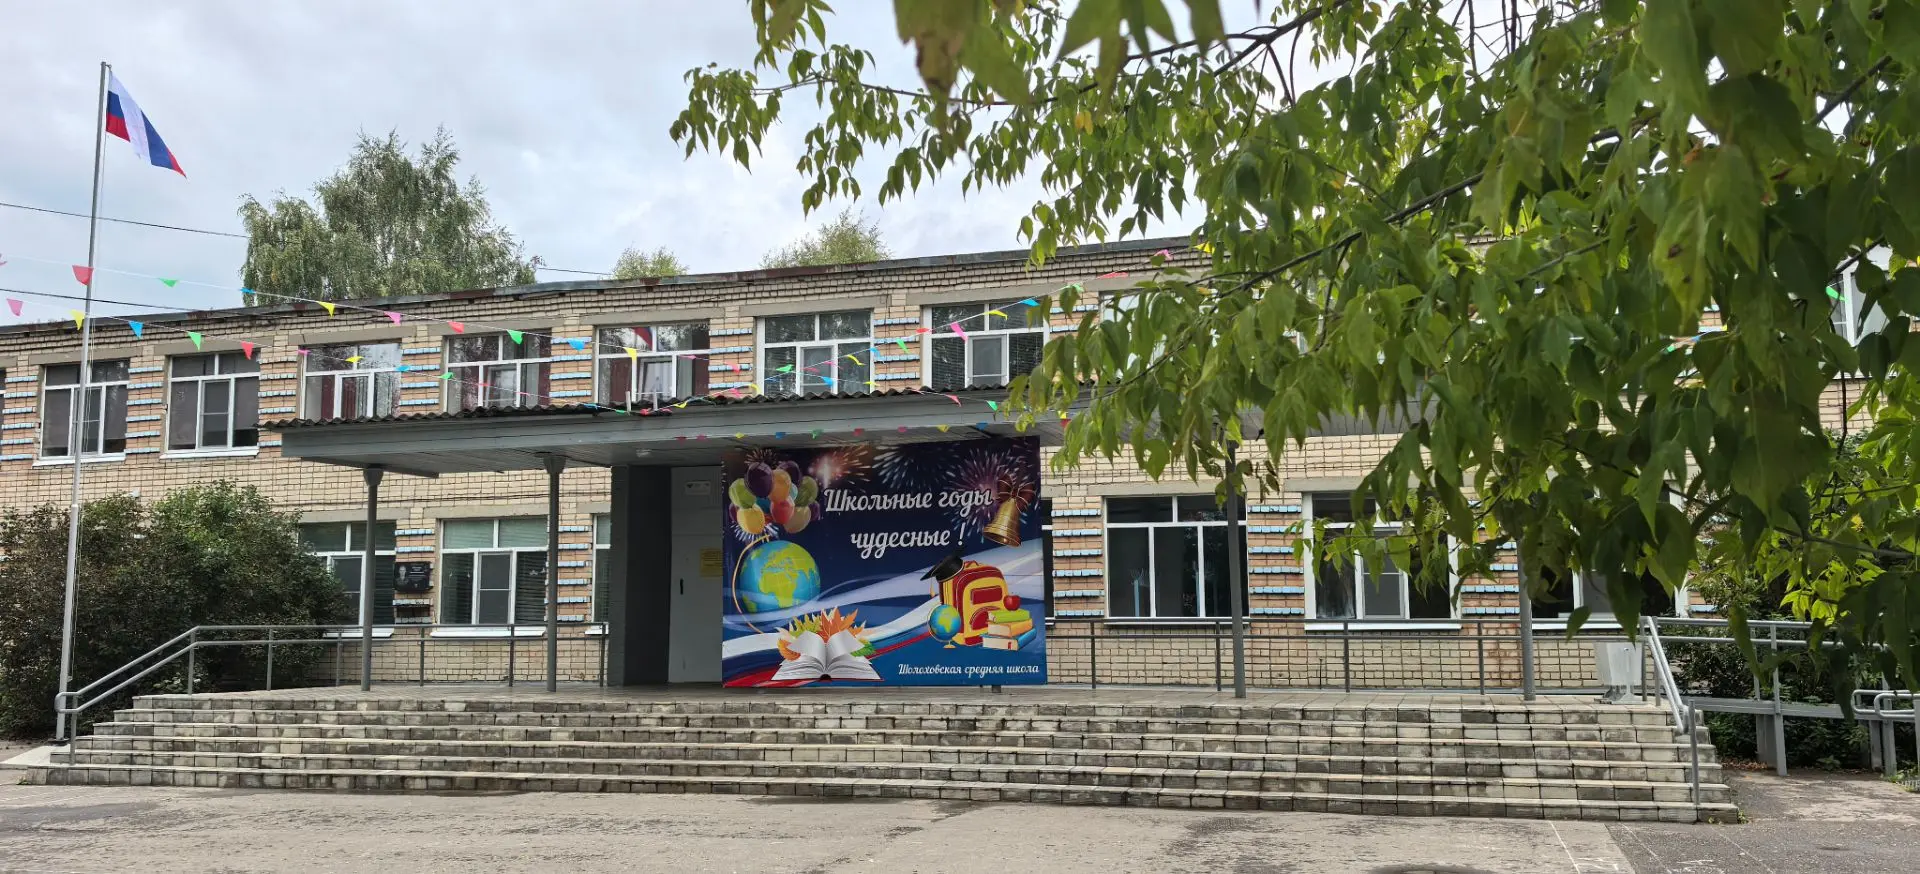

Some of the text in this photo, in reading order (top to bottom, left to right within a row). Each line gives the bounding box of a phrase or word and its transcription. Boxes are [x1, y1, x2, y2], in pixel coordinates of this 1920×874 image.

[824, 488, 993, 517] Школьные годы
[850, 529, 950, 559] чудесные
[898, 663, 1039, 678] Шолоховская средняя школа
